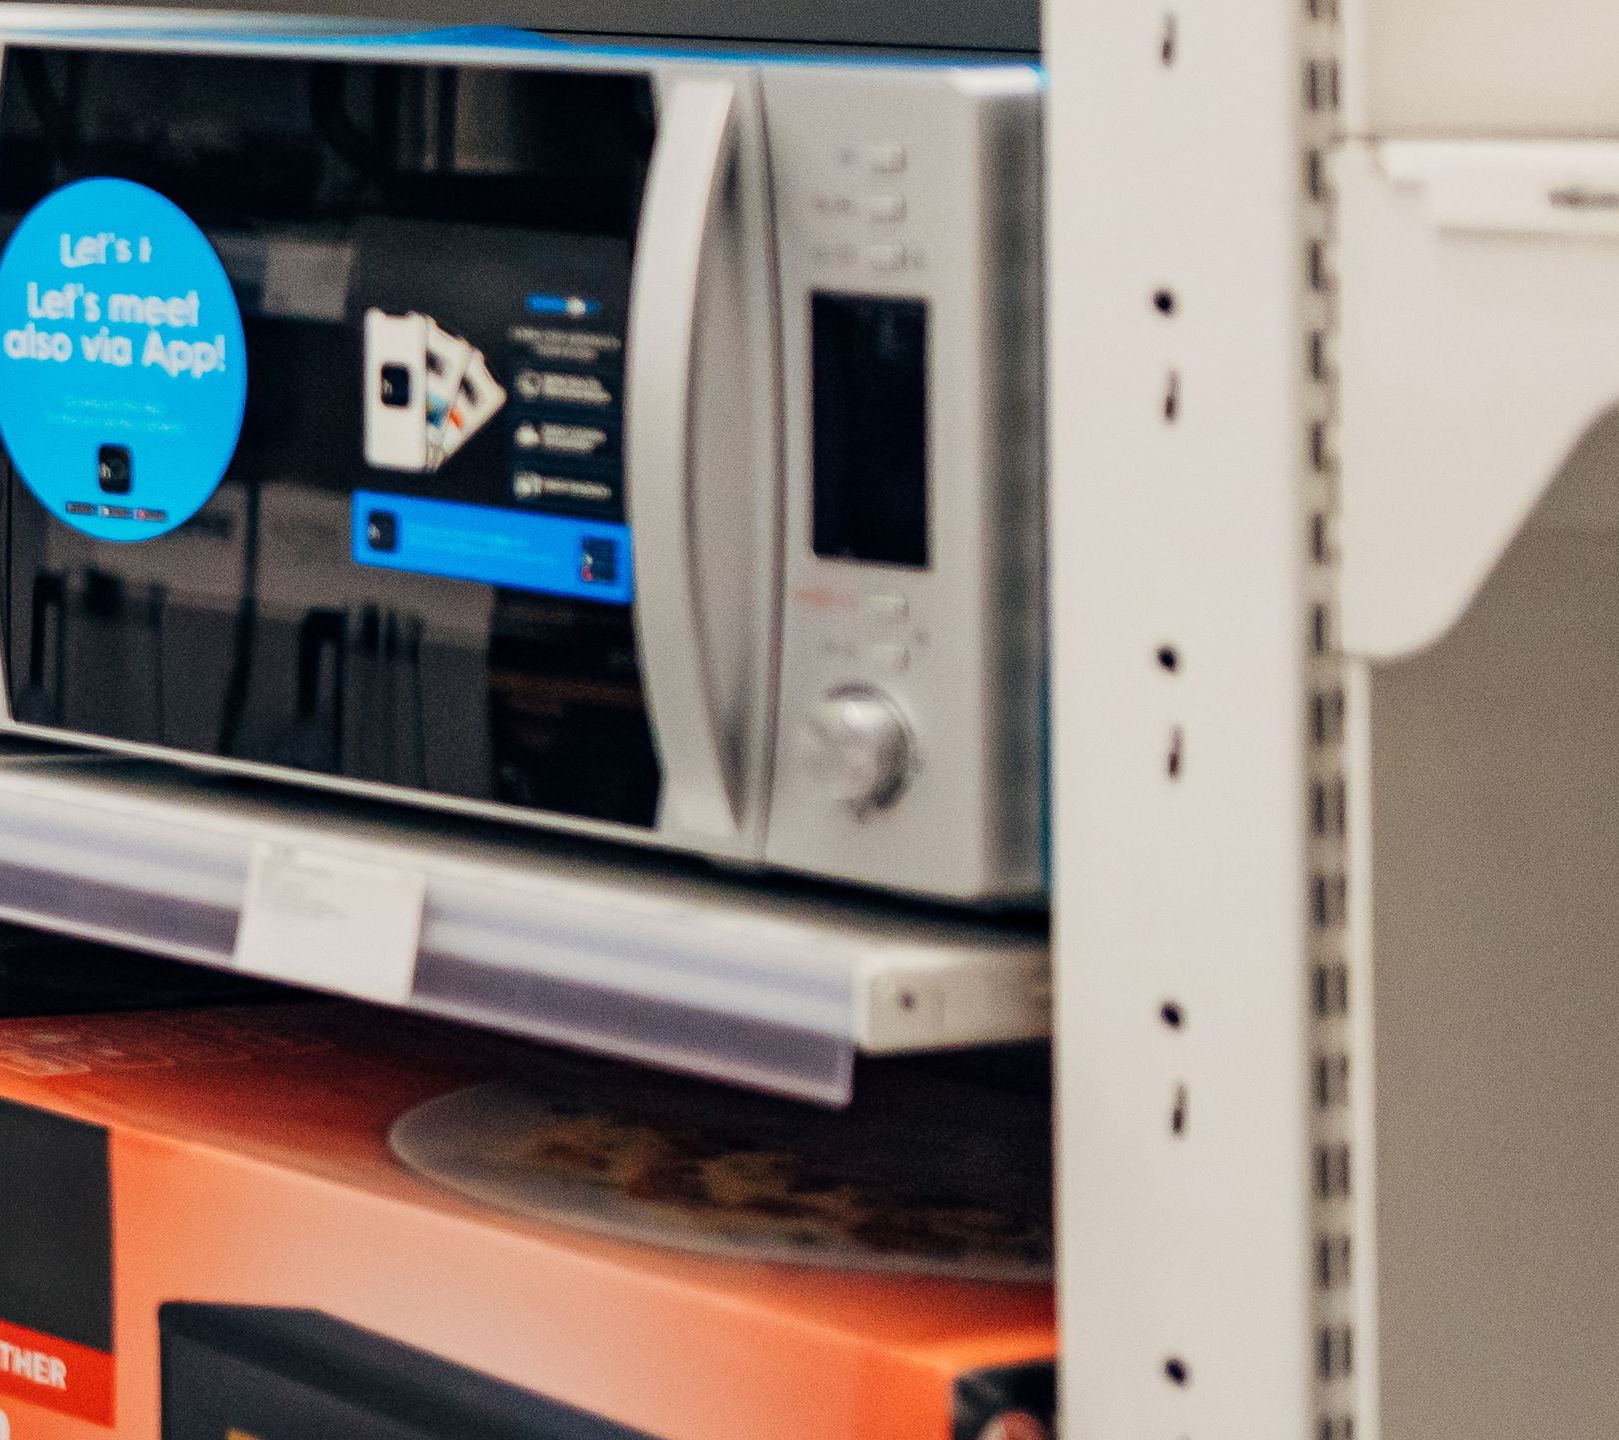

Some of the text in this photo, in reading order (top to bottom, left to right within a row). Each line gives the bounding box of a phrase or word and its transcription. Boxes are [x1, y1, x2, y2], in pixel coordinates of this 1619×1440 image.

[59, 232, 132, 268] Let's
[26, 280, 200, 328] Let's meet
[2, 321, 227, 379] also via App!
